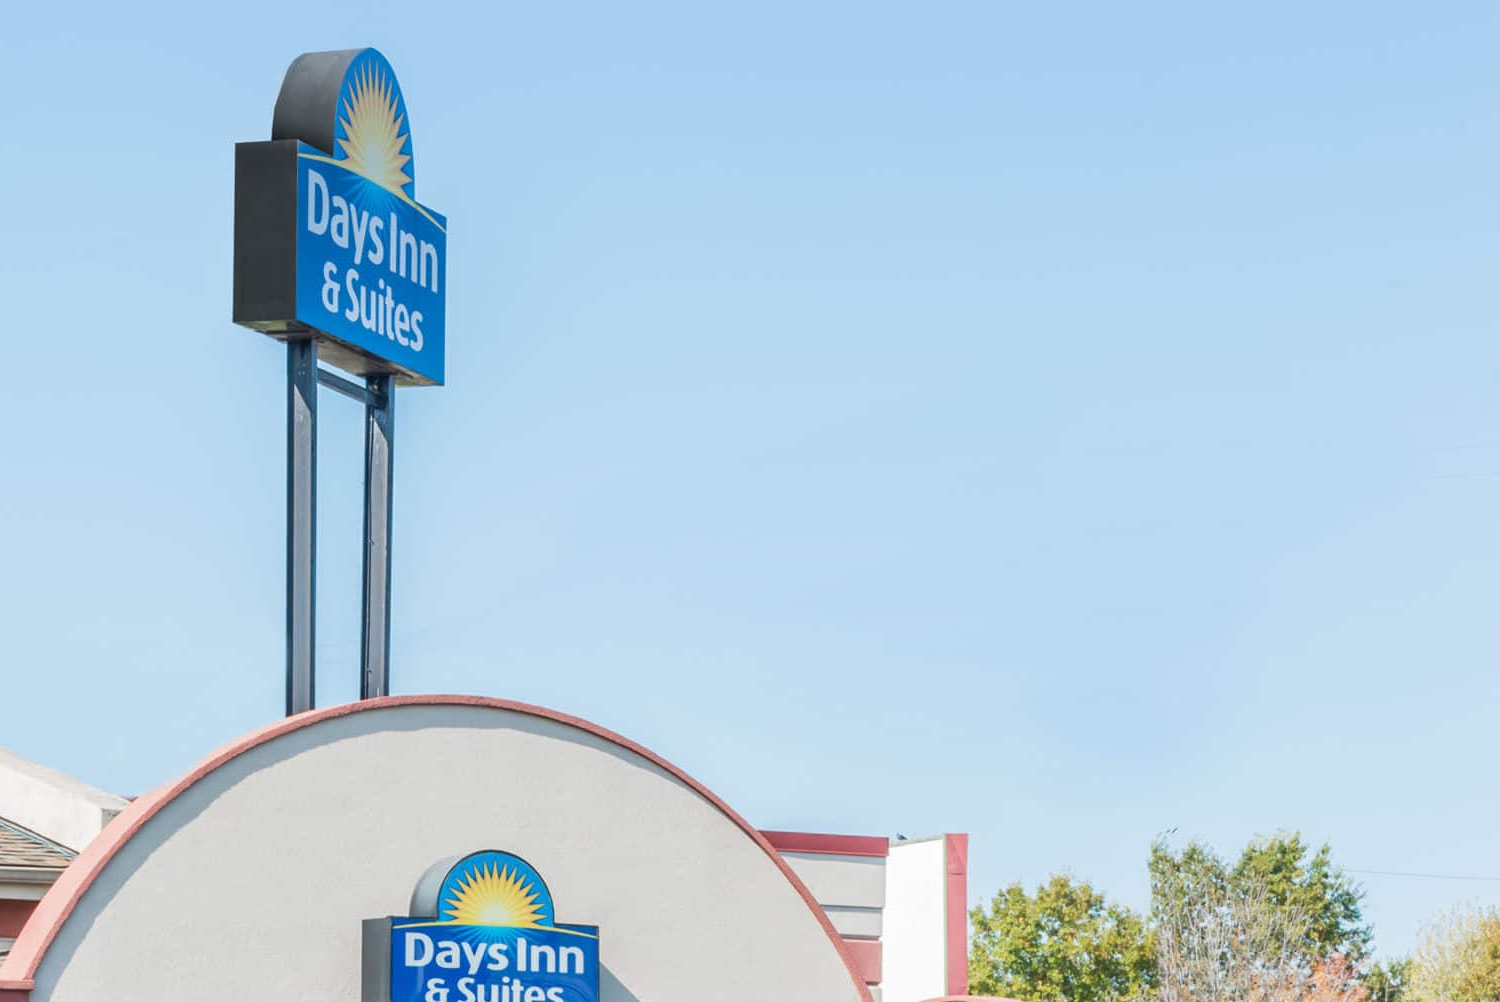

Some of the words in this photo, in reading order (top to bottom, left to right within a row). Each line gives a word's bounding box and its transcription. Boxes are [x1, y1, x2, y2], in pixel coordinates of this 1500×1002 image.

[308, 168, 384, 265] Days
[389, 212, 438, 294] Inn
[322, 261, 341, 314] &
[345, 267, 424, 352] Suites
[404, 932, 509, 975] Days
[517, 937, 585, 974] Inn
